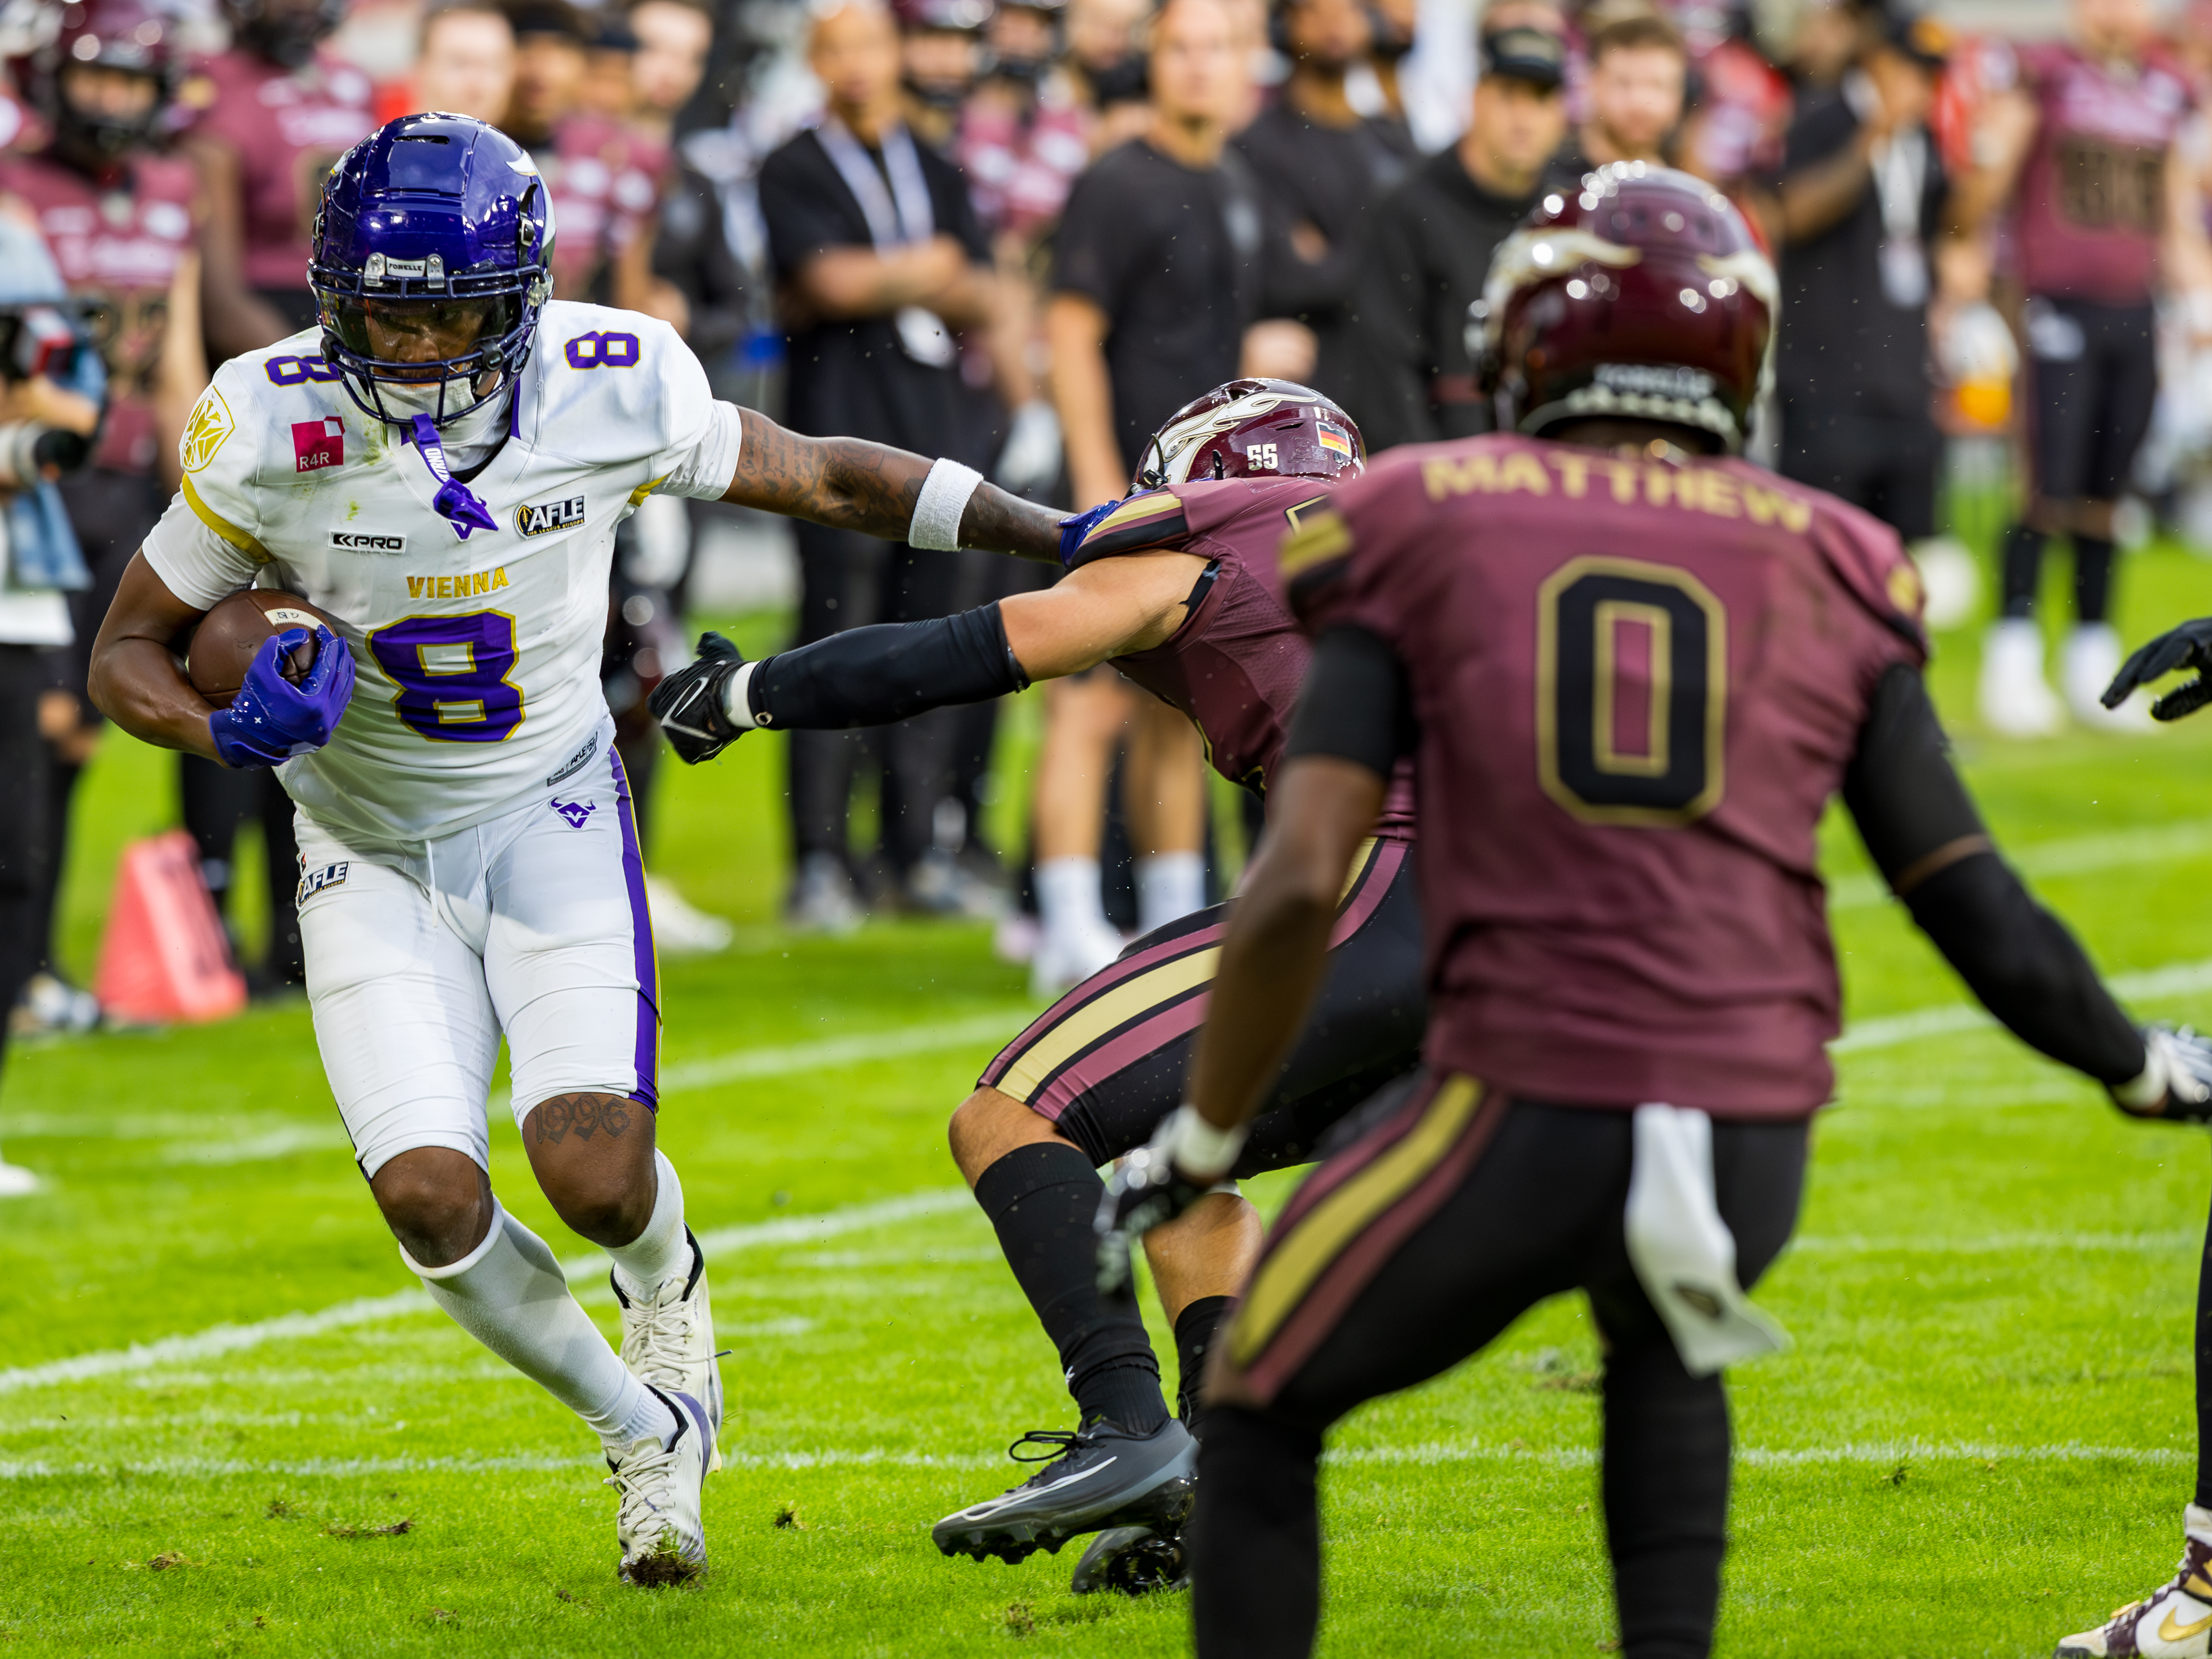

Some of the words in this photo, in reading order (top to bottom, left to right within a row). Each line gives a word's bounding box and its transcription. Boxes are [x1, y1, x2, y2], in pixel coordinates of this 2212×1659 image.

[564, 330, 641, 370] 8
[263, 354, 342, 388] 8
[300, 452, 329, 469] R4R
[1247, 443, 1278, 471] 55
[1422, 451, 1812, 534] MATTHEW
[528, 497, 583, 531] AFLE
[539, 524, 561, 534] LEAGUE
[563, 519, 584, 528] EUROPE
[406, 566, 509, 598] VIENNA
[365, 607, 526, 743] 8
[1536, 555, 1728, 828] 0
[301, 863, 347, 902] AFLE
[533, 1093, 631, 1144] 1996
